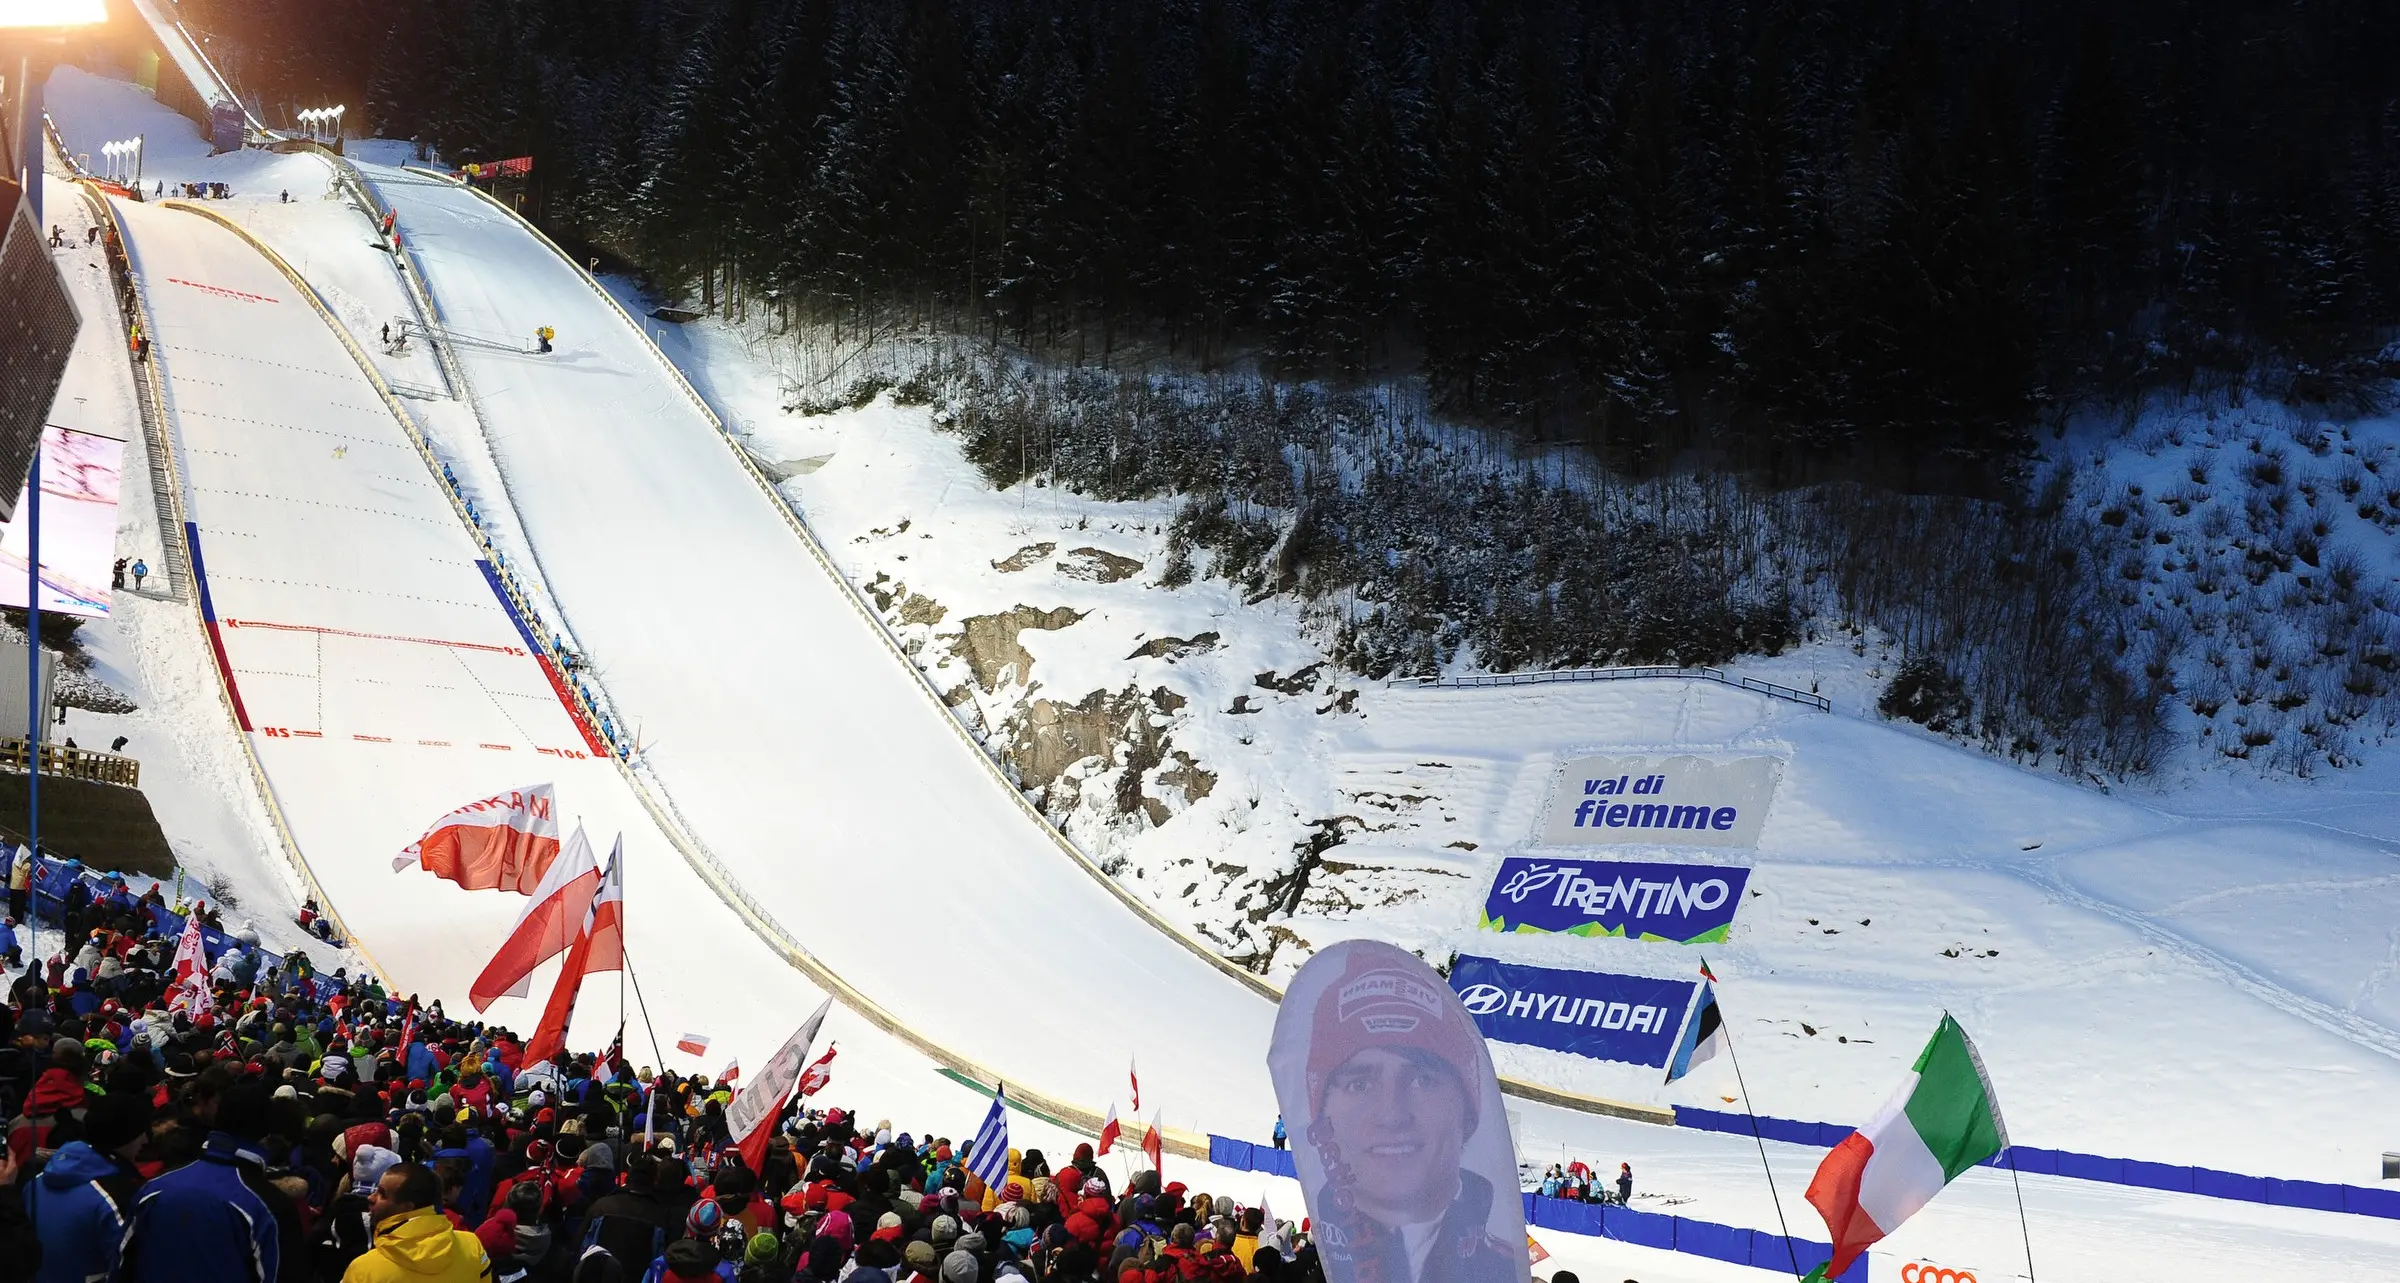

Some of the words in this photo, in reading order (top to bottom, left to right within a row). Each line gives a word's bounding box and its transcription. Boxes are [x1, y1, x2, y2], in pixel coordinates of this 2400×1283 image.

[226, 618, 239, 628] K
[503, 646, 524, 656] 95
[264, 726, 290, 738] HS
[554, 748, 585, 759] 106
[1584, 775, 1629, 795] val
[1632, 775, 1665, 795] di
[1573, 799, 1737, 831] fiemme
[1551, 867, 1729, 919] TRENTINO
[1506, 990, 1668, 1035] HYUNDAI
